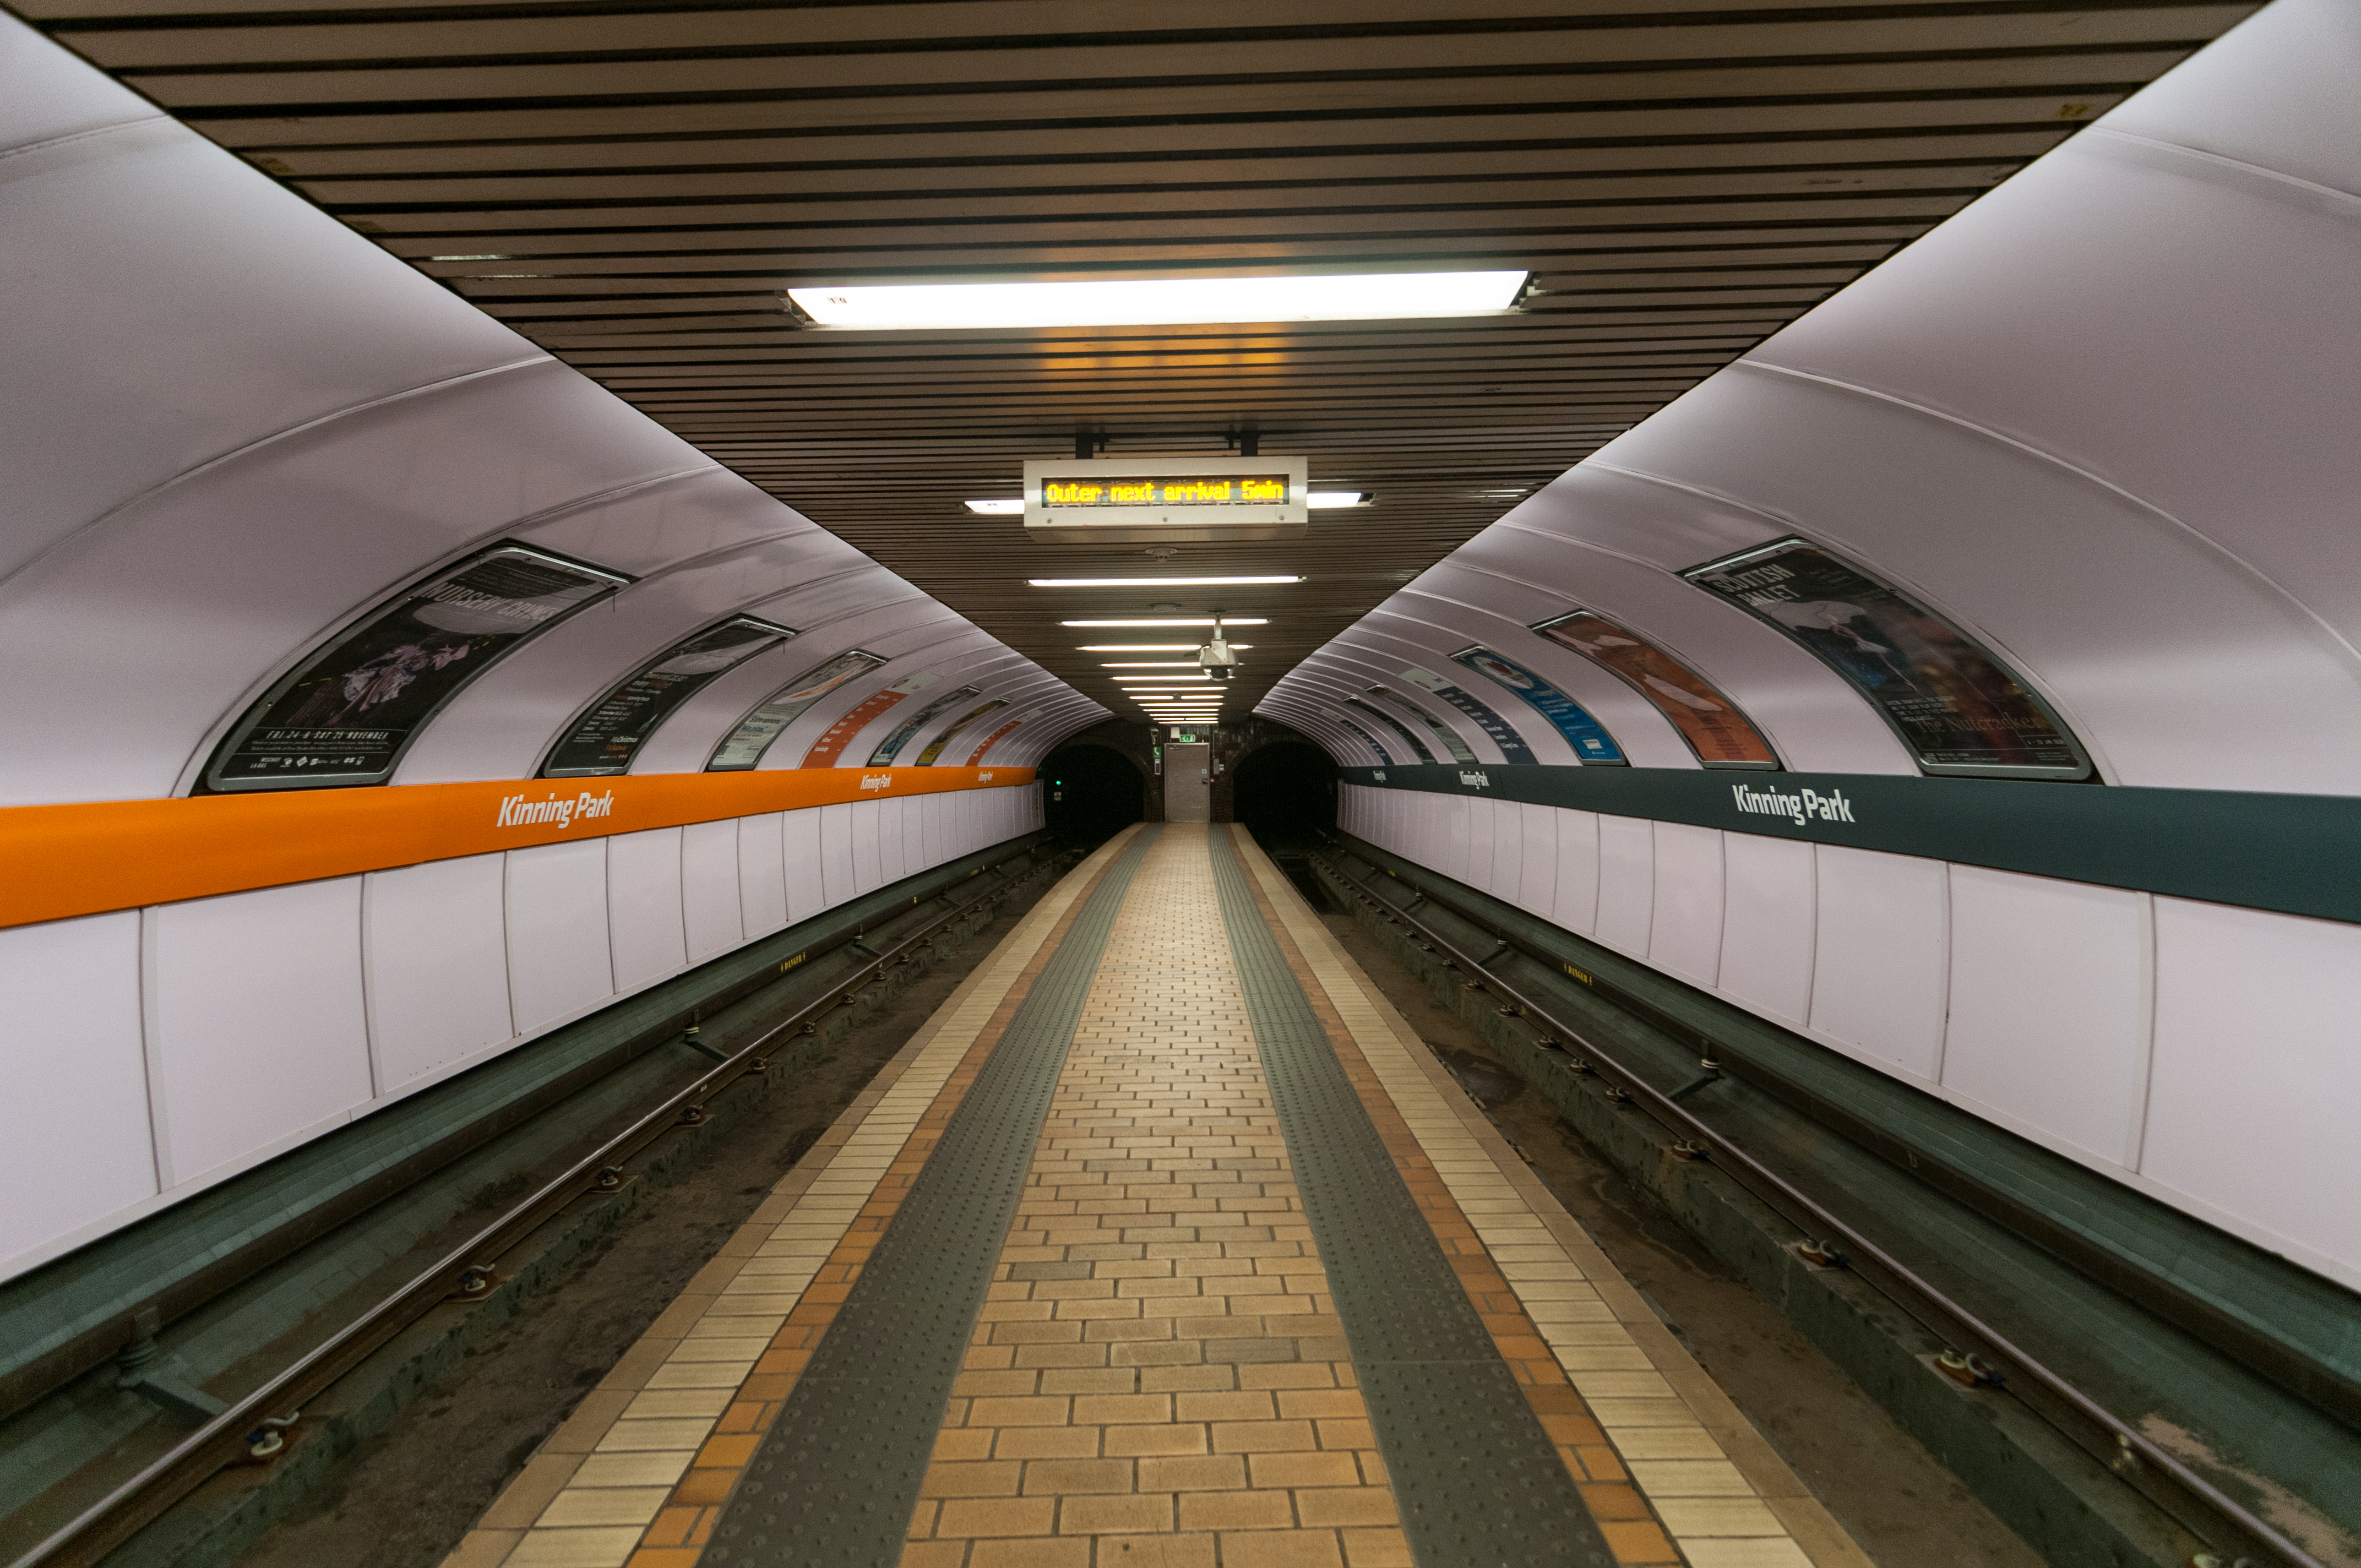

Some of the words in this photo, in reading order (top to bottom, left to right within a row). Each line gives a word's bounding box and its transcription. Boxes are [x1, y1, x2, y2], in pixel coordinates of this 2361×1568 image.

[1047, 483, 1102, 502] Outer
[1111, 482, 1155, 502] next
[1164, 481, 1230, 501] arrival
[1242, 480, 1283, 499] 5min
[1712, 564, 1796, 592] SCOTTISH
[421, 581, 512, 611] NURSERY
[1736, 584, 1800, 606] BALLET
[1914, 717, 1946, 733] The
[1944, 712, 2043, 732] Nutcracker
[859, 774, 881, 793] Kinning
[879, 773, 892, 788] Park
[1459, 770, 1480, 790] Kinning
[1475, 771, 1490, 786] Park
[496, 792, 576, 829] Kinning
[573, 790, 614, 819] Park
[1732, 784, 1807, 826] Kinning
[1800, 788, 1856, 823] Park
[785, 954, 802, 970] DANGER
[1568, 965, 1588, 983] DANGER
